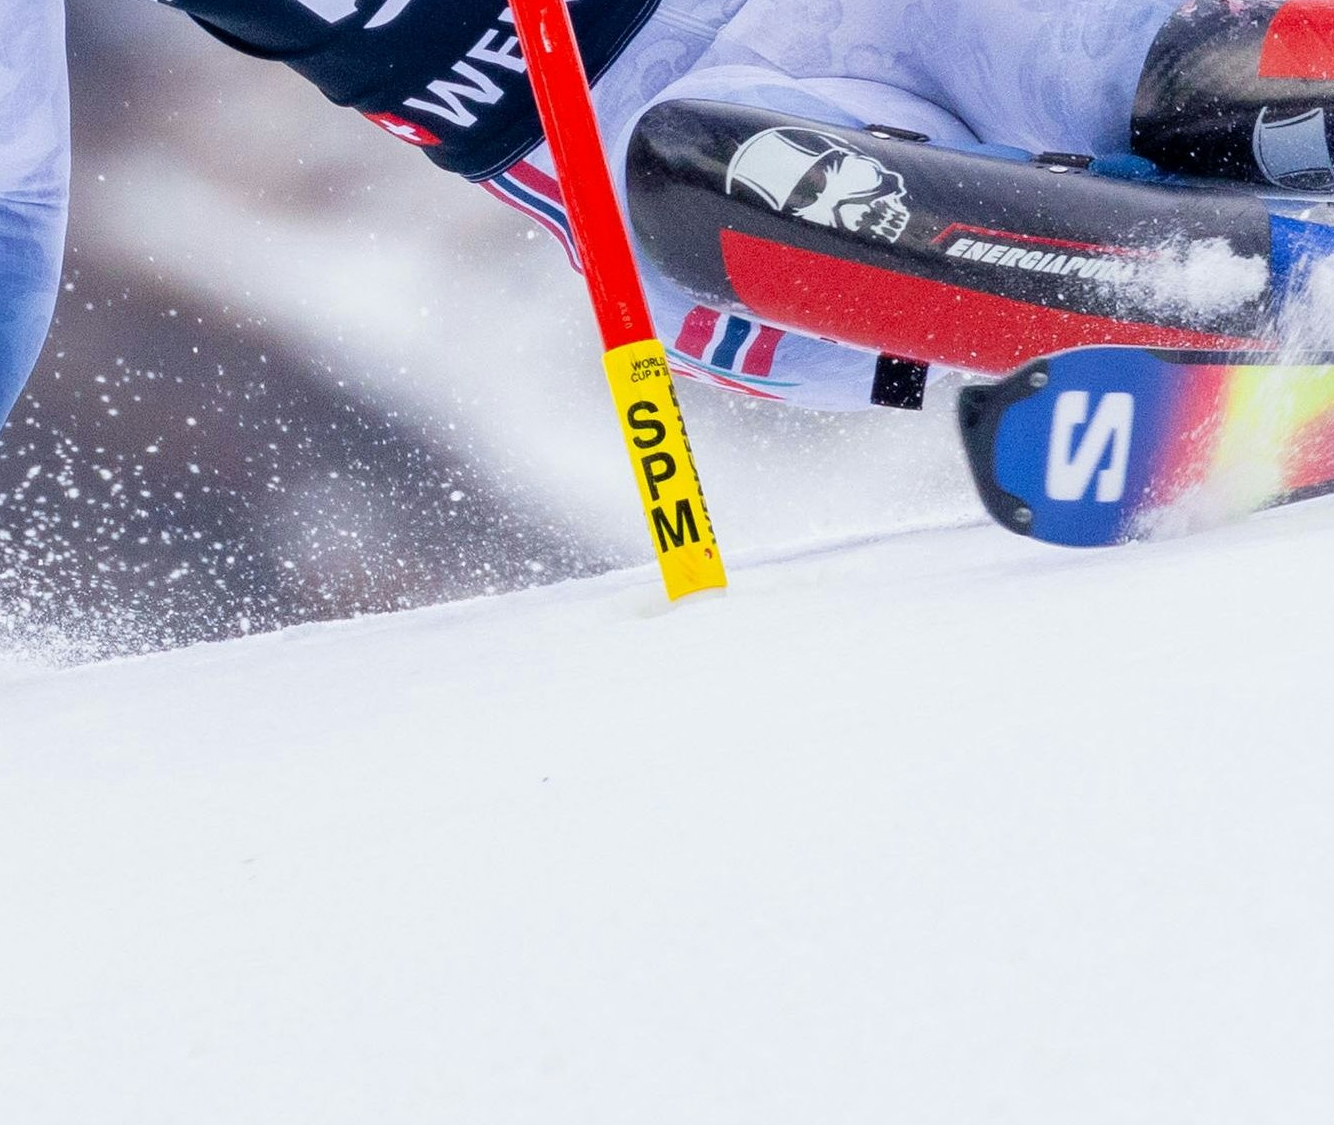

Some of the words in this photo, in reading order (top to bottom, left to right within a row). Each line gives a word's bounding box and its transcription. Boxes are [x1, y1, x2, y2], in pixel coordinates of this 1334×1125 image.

[630, 357, 666, 371] WORLD
[631, 371, 652, 383] CUP
[627, 400, 700, 554] SPM
